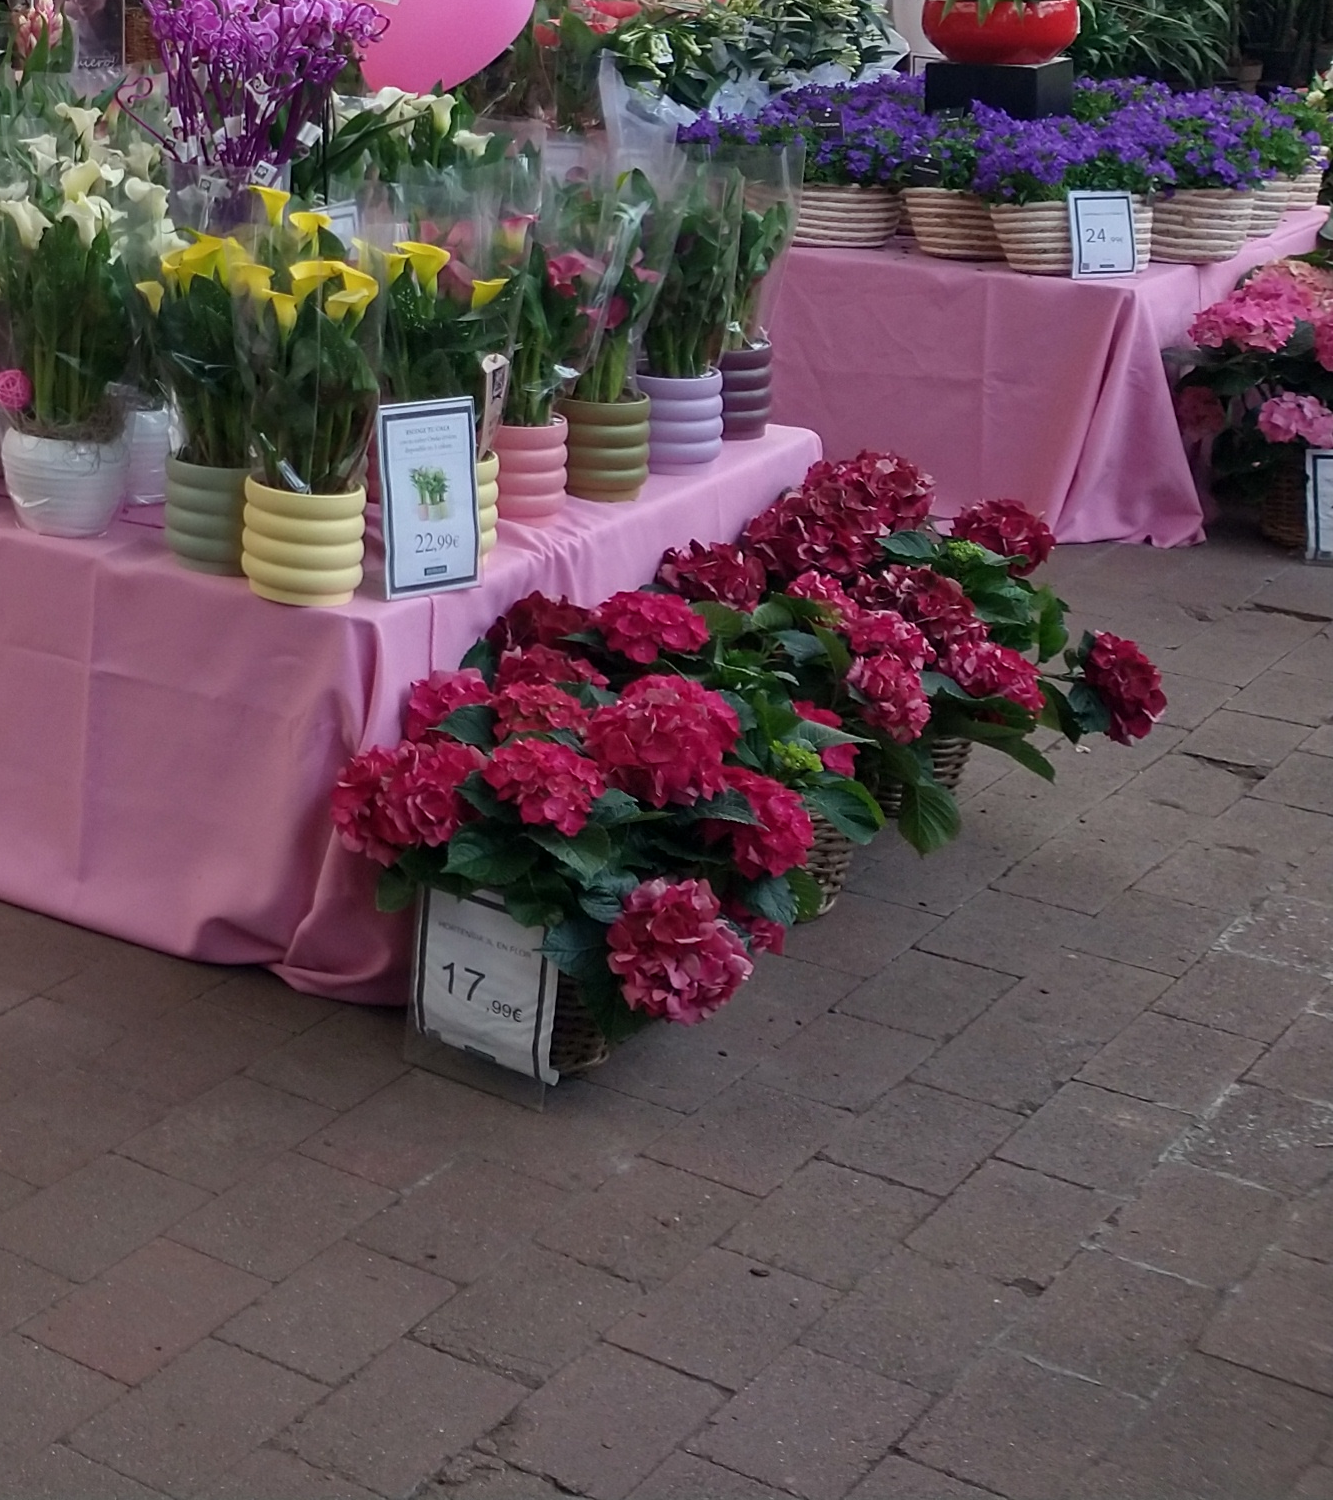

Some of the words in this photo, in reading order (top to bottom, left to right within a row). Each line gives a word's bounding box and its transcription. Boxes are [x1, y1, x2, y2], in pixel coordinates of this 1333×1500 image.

[1085, 228, 1106, 243] 24
[414, 531, 460, 555] 22,99€
[496, 943, 509, 952] EN
[441, 961, 486, 1002] 17
